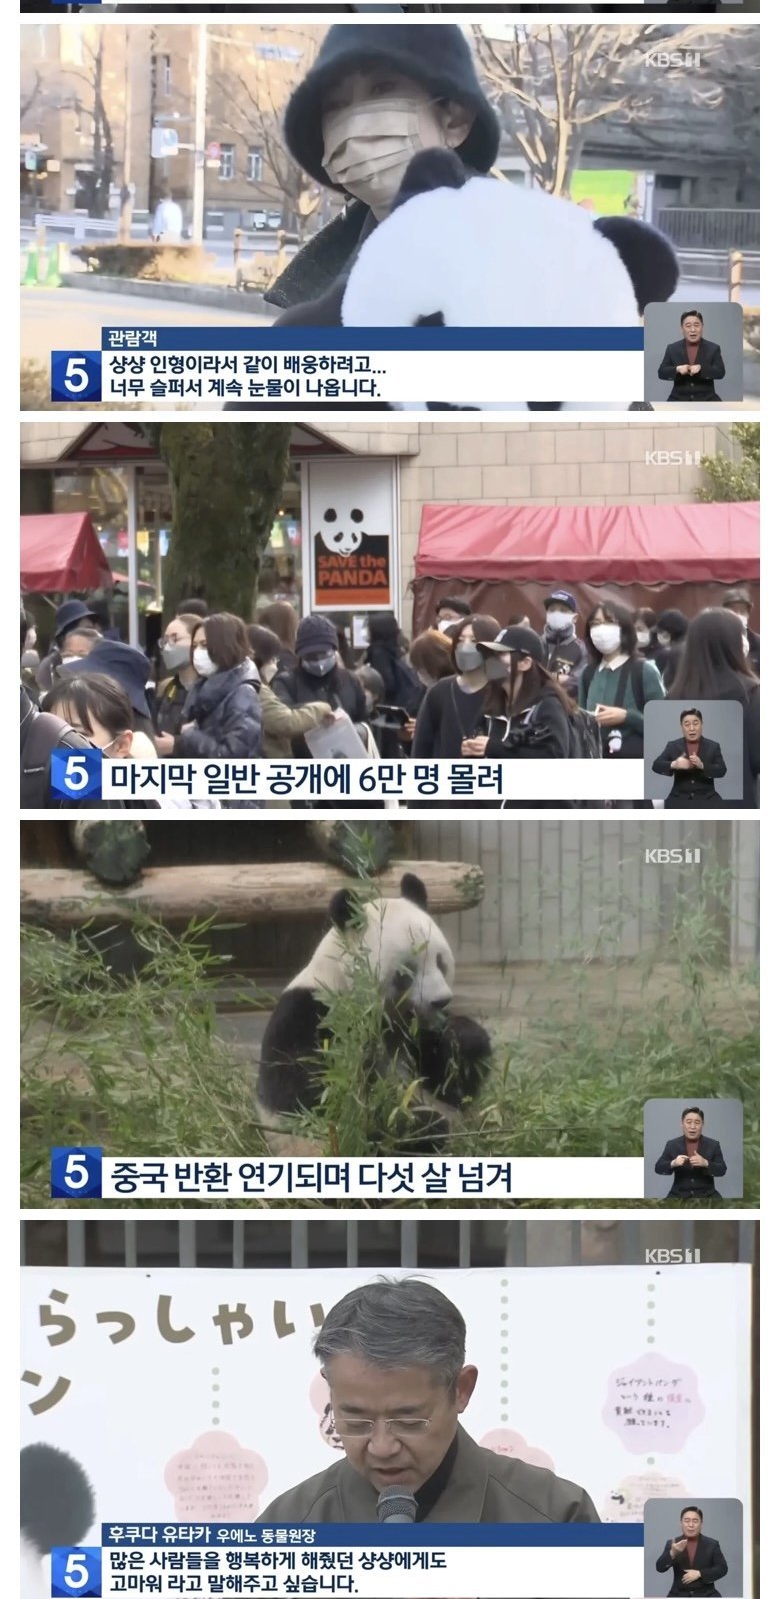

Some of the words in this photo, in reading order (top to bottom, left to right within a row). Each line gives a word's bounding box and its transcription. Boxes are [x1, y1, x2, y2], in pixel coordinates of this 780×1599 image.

[318, 555, 357, 569] SAVE
[360, 554, 386, 568] the
[318, 569, 388, 586] PANDA
